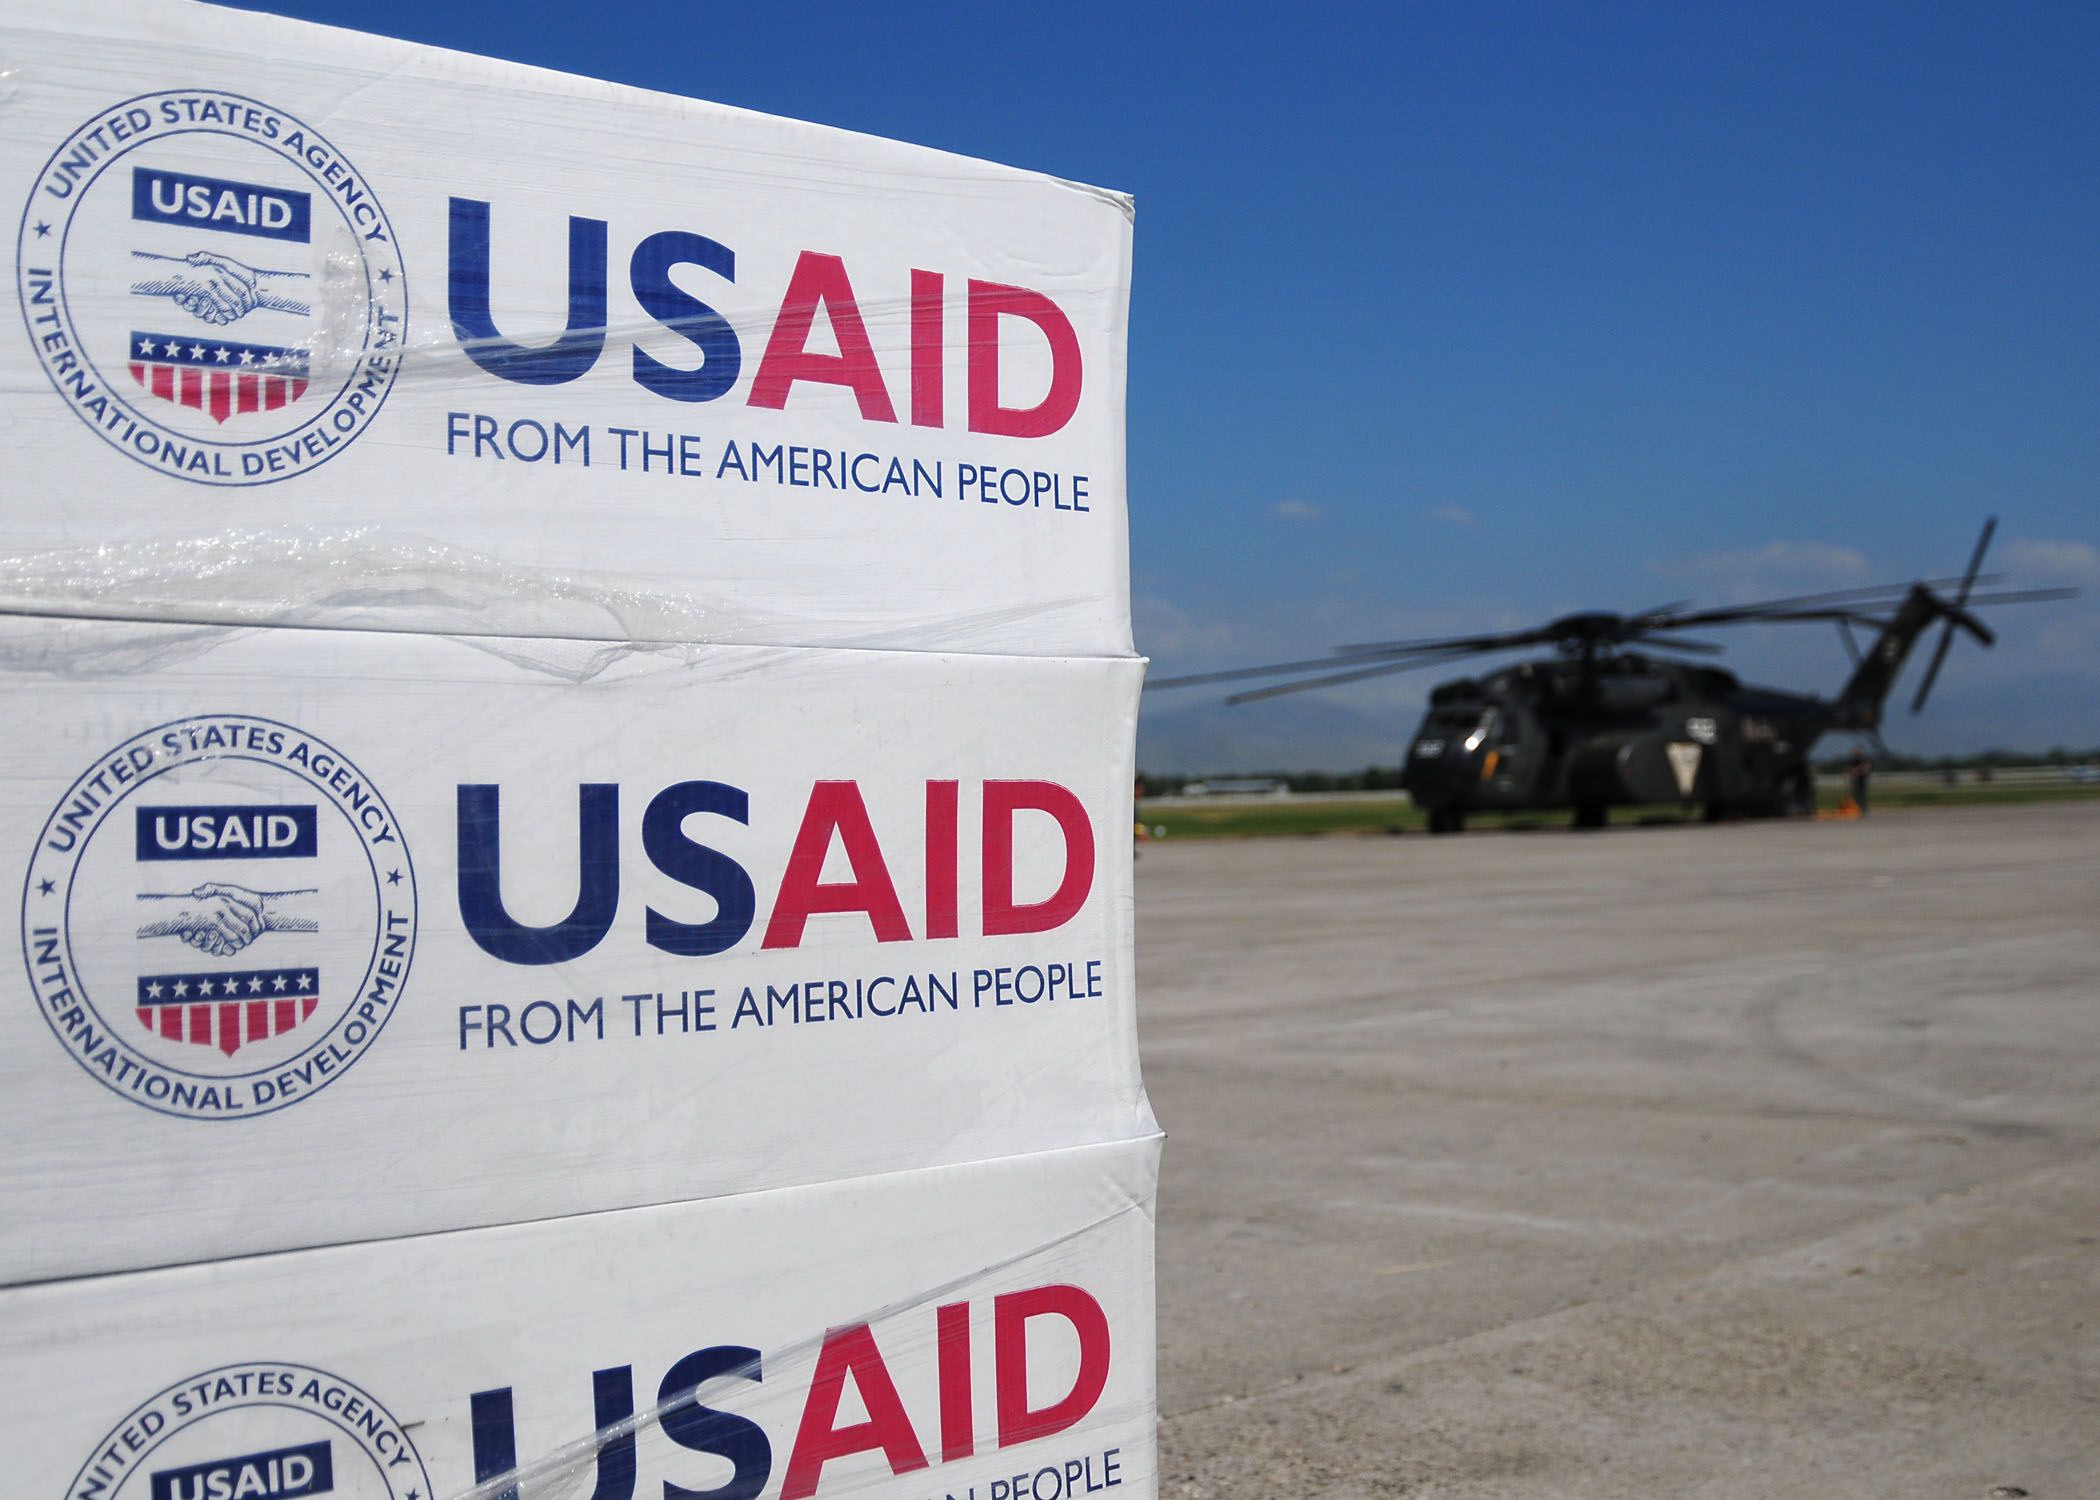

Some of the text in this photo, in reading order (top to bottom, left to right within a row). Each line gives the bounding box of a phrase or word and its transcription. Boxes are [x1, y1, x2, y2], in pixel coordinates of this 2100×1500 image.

[45, 98, 388, 244] UNITED STATES AGENCY
[151, 179, 292, 229] USAID
[28, 268, 400, 476] INTERNATIONAL DEVELOPMENT
[448, 196, 1083, 438] USAID
[447, 412, 1090, 513] FROM THE AMERICAN PEOPLE
[48, 724, 396, 853] UNITED STATES AGENCY
[155, 815, 299, 850] USAID
[457, 779, 1096, 966] USAID
[32, 910, 409, 1110] INTERNATIONAL DEVELOPMENT
[459, 961, 1103, 1050] FROM THE AMERICAN PEOPLE
[77, 1371, 411, 1500] NITED STATES AGENCY
[470, 1282, 1111, 1500] USAID
[170, 1455, 314, 1500] USAID
